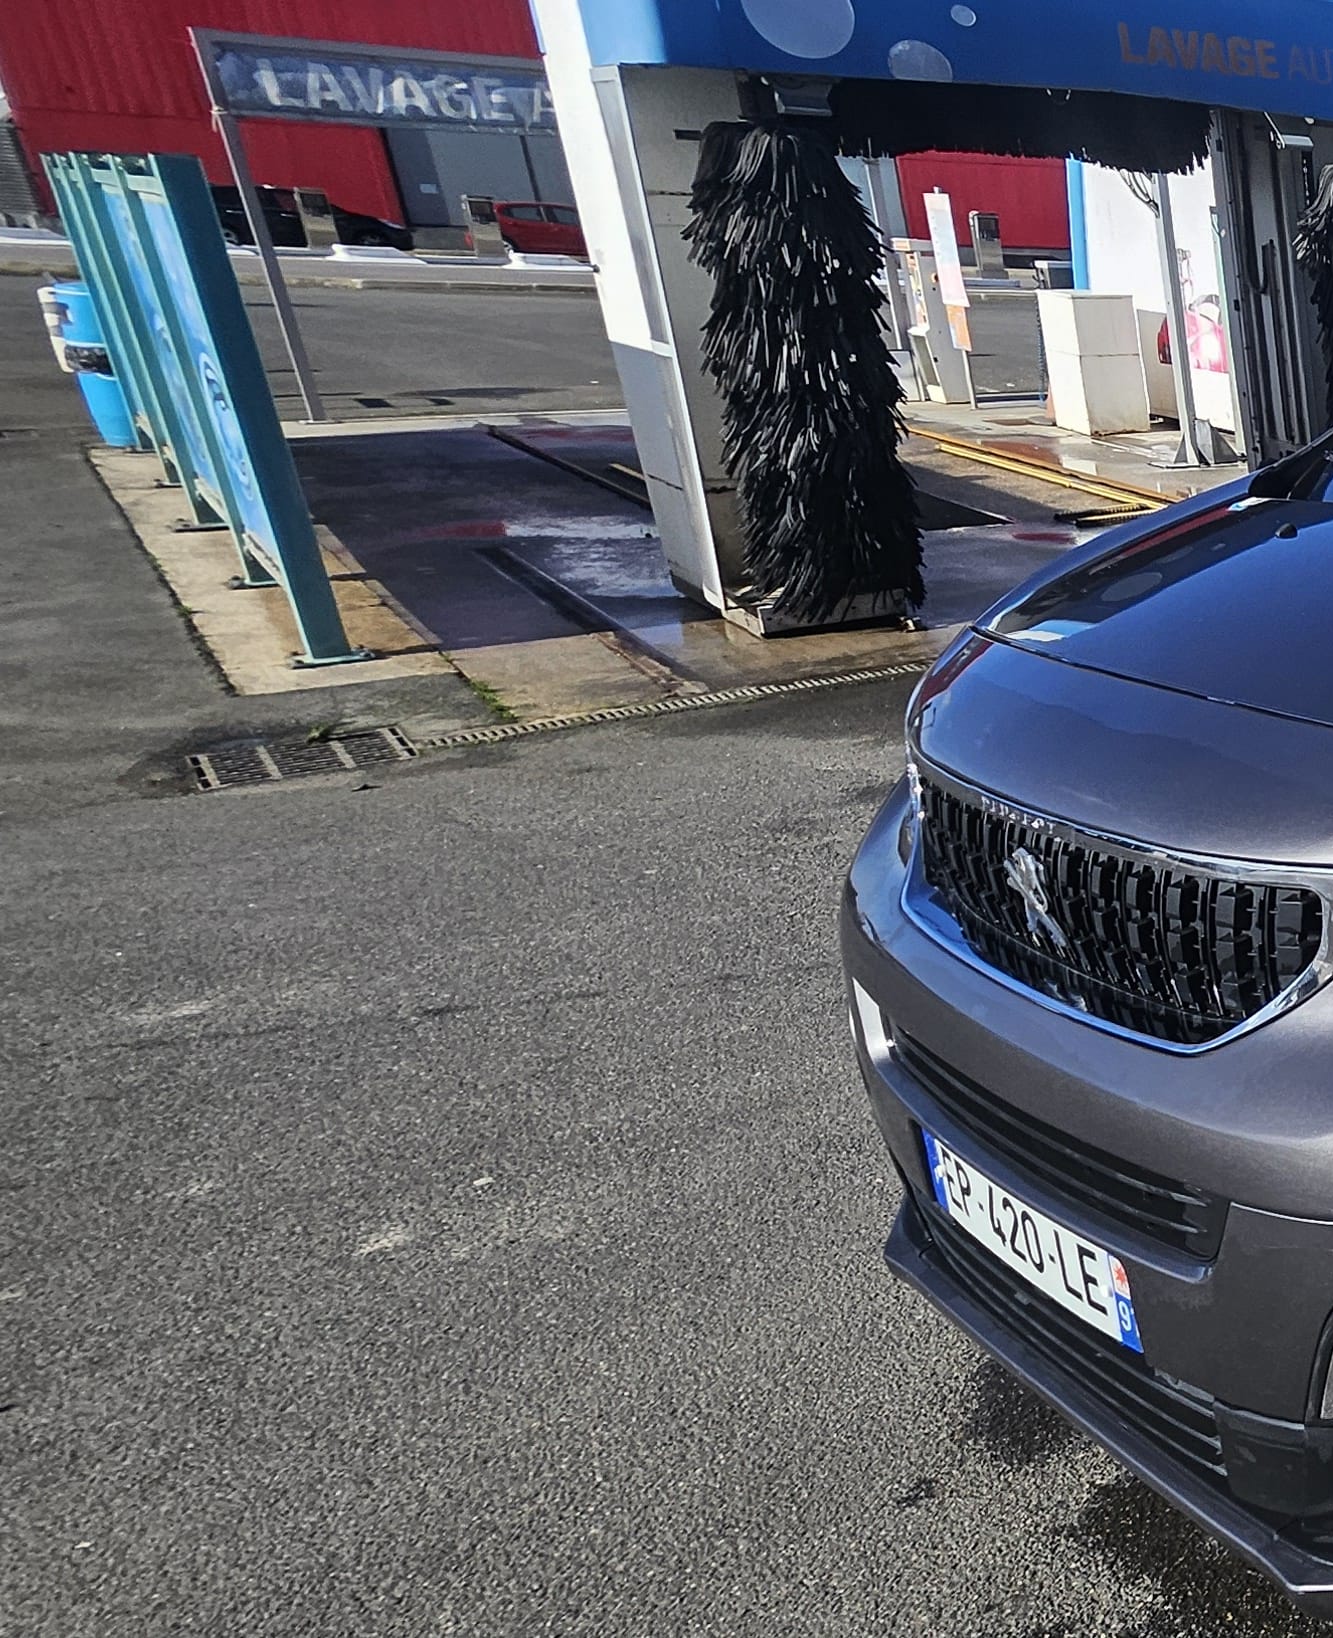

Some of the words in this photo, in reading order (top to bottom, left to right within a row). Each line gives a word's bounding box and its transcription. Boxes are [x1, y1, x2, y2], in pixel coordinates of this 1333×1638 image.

[1117, 21, 1281, 80] LAVAGE
[253, 58, 516, 121] LAVAGE
[940, 1145, 1109, 1317] EP-420-LE
